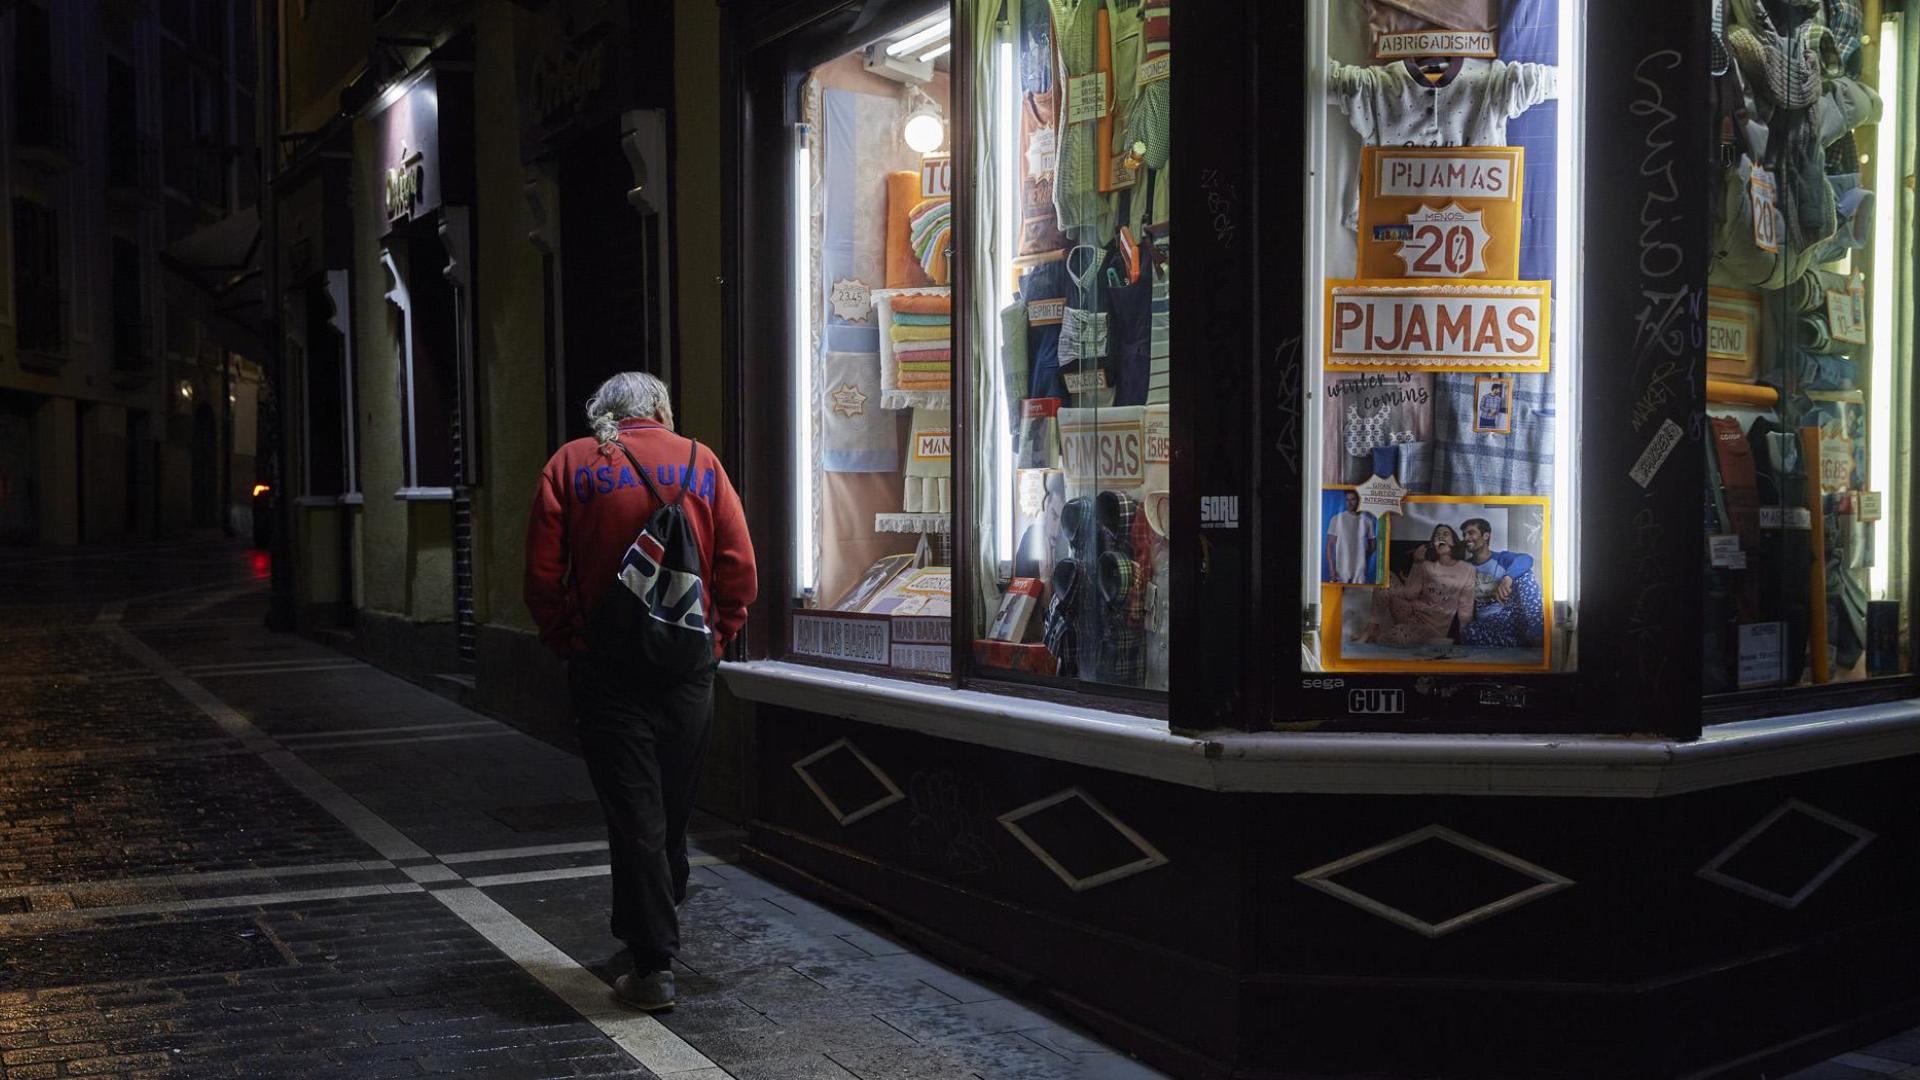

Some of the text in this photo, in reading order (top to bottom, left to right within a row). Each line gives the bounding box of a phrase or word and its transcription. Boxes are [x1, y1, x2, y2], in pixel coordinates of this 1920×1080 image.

[1391, 162, 1502, 192] PIJAMAS
[1425, 213, 1465, 222] MENOS
[1334, 302, 1537, 354] PIJAMAS
[1327, 371, 1386, 398] winter
[1364, 386, 1430, 410] coming
[1301, 678, 1345, 690] sega
